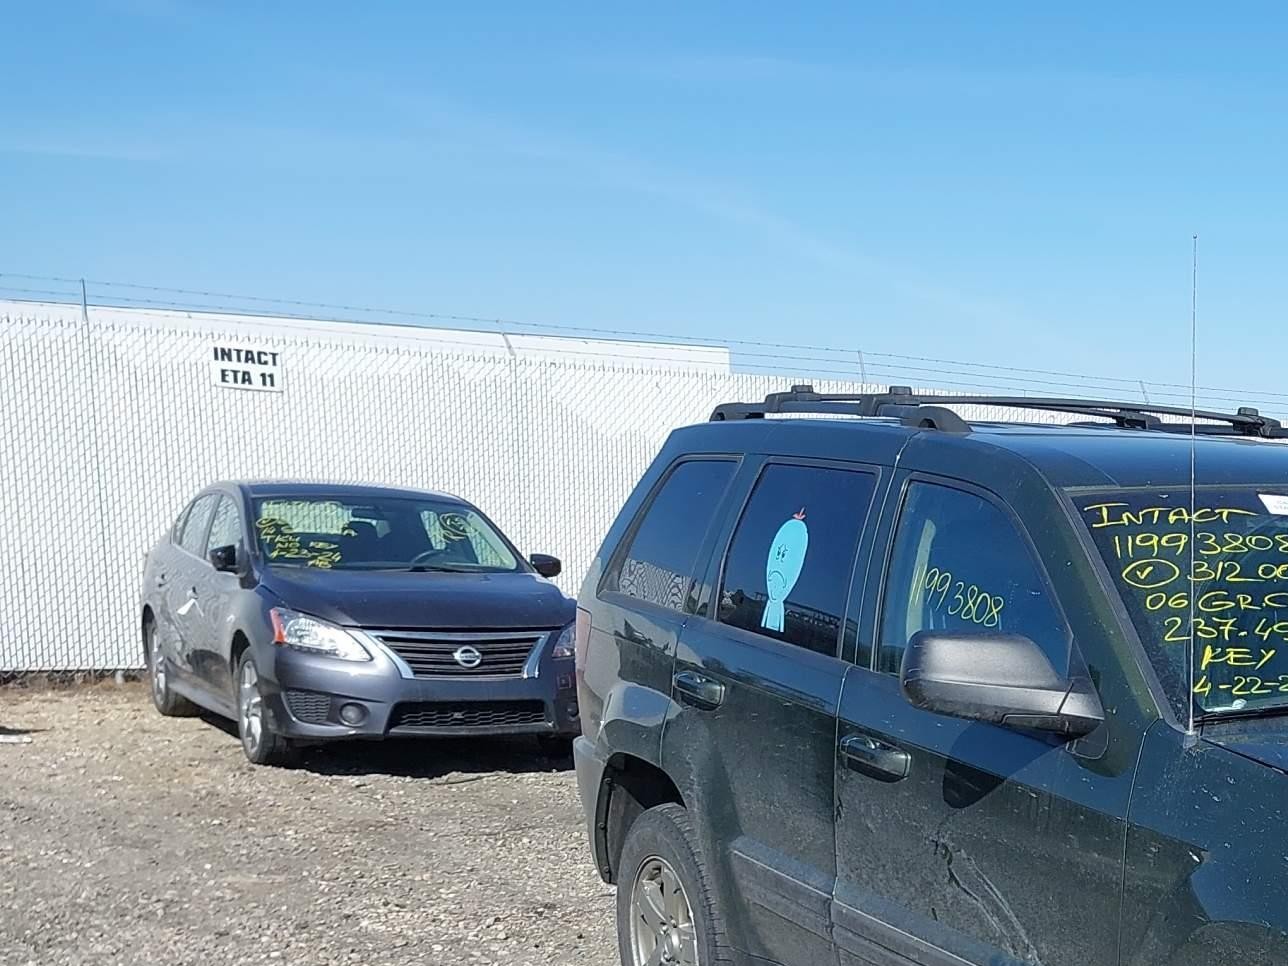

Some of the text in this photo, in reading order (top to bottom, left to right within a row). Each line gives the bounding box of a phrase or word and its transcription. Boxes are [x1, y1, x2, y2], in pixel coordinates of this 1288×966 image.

[214, 347, 279, 366] INTACT
[221, 369, 275, 387] ETA 11
[1083, 503, 1260, 528] INTACT
[1201, 645, 1276, 670] KEY
